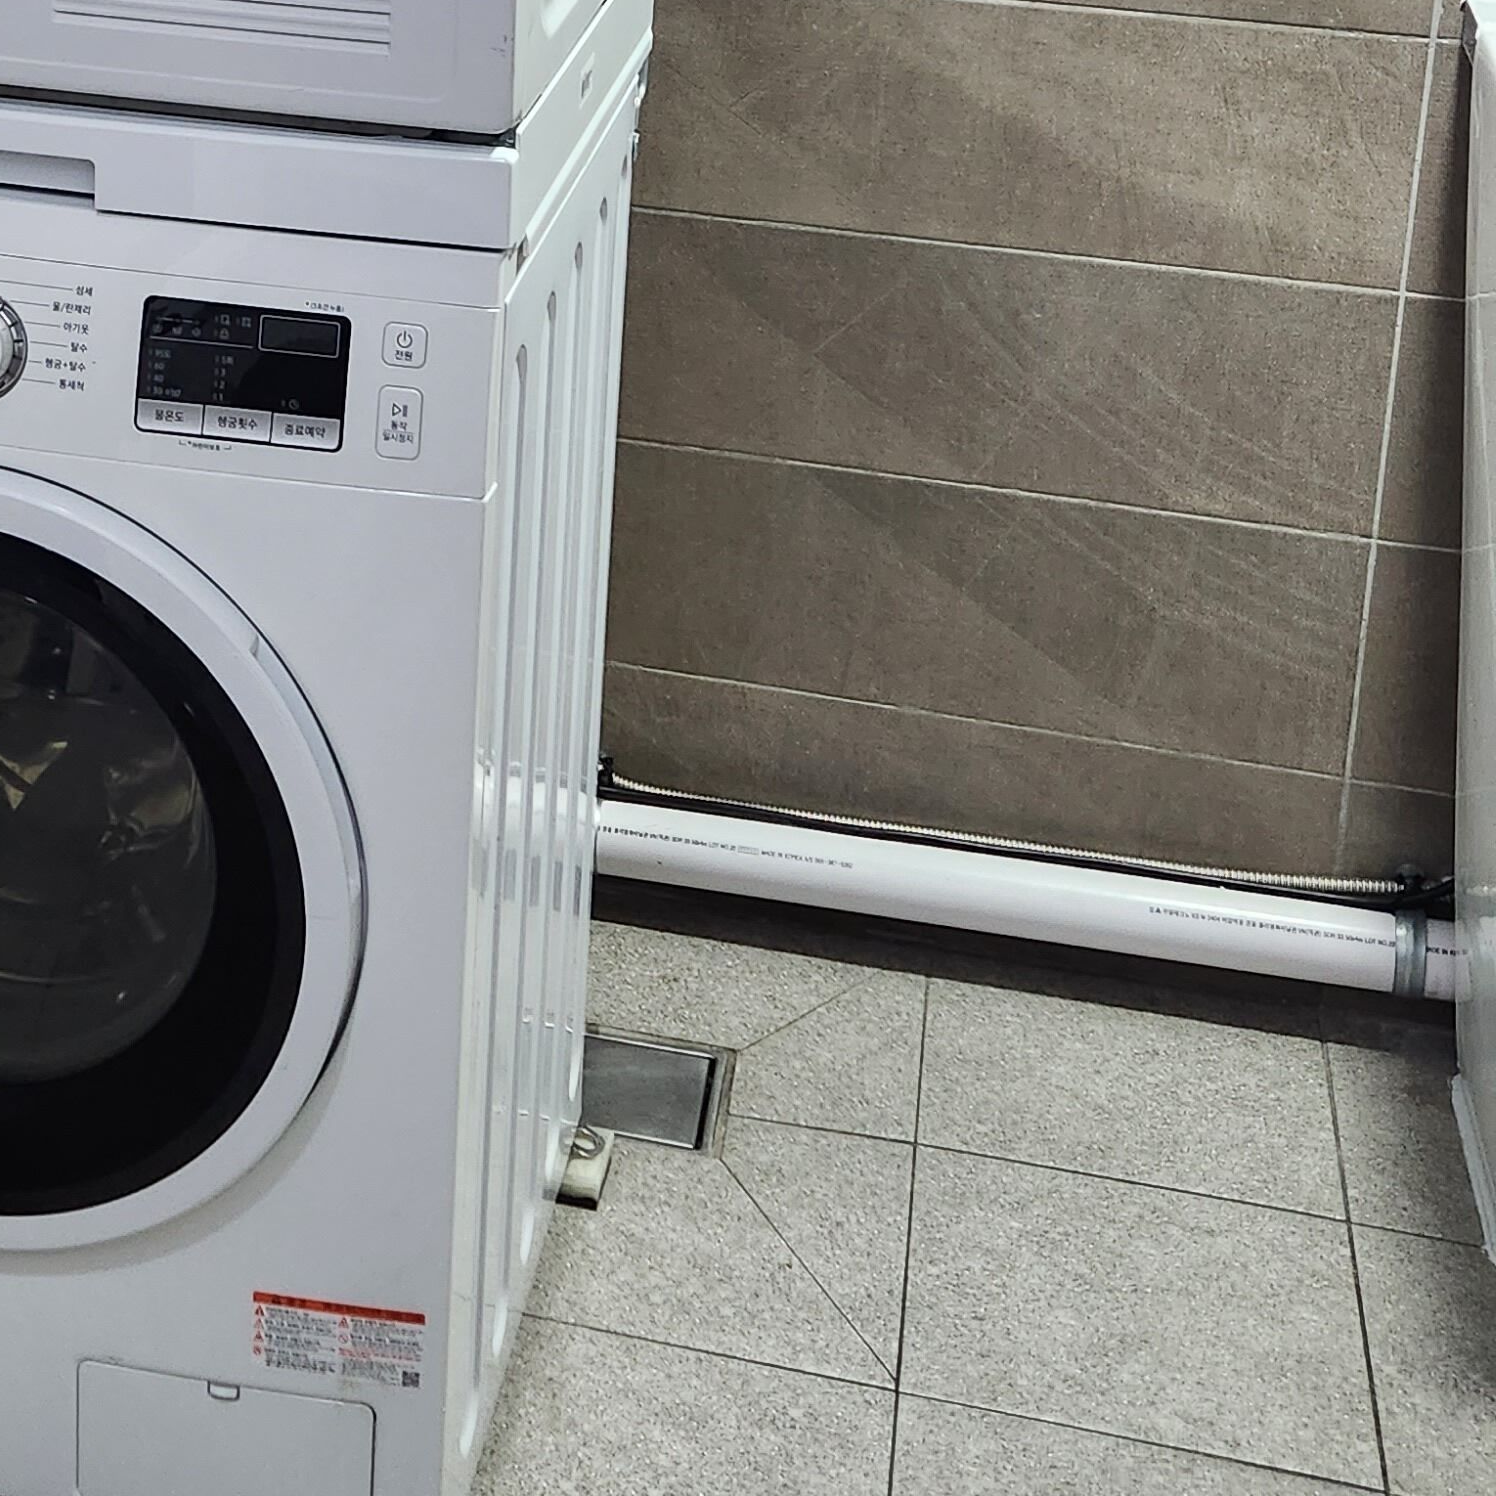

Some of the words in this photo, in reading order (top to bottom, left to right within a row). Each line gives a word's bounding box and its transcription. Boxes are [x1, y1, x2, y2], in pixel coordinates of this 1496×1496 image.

[76, 286, 93, 297] 섬세
[63, 322, 89, 335] 아기옷
[70, 342, 88, 353] 탈수
[395, 350, 413, 362] 전원
[155, 409, 185, 422] 물온도
